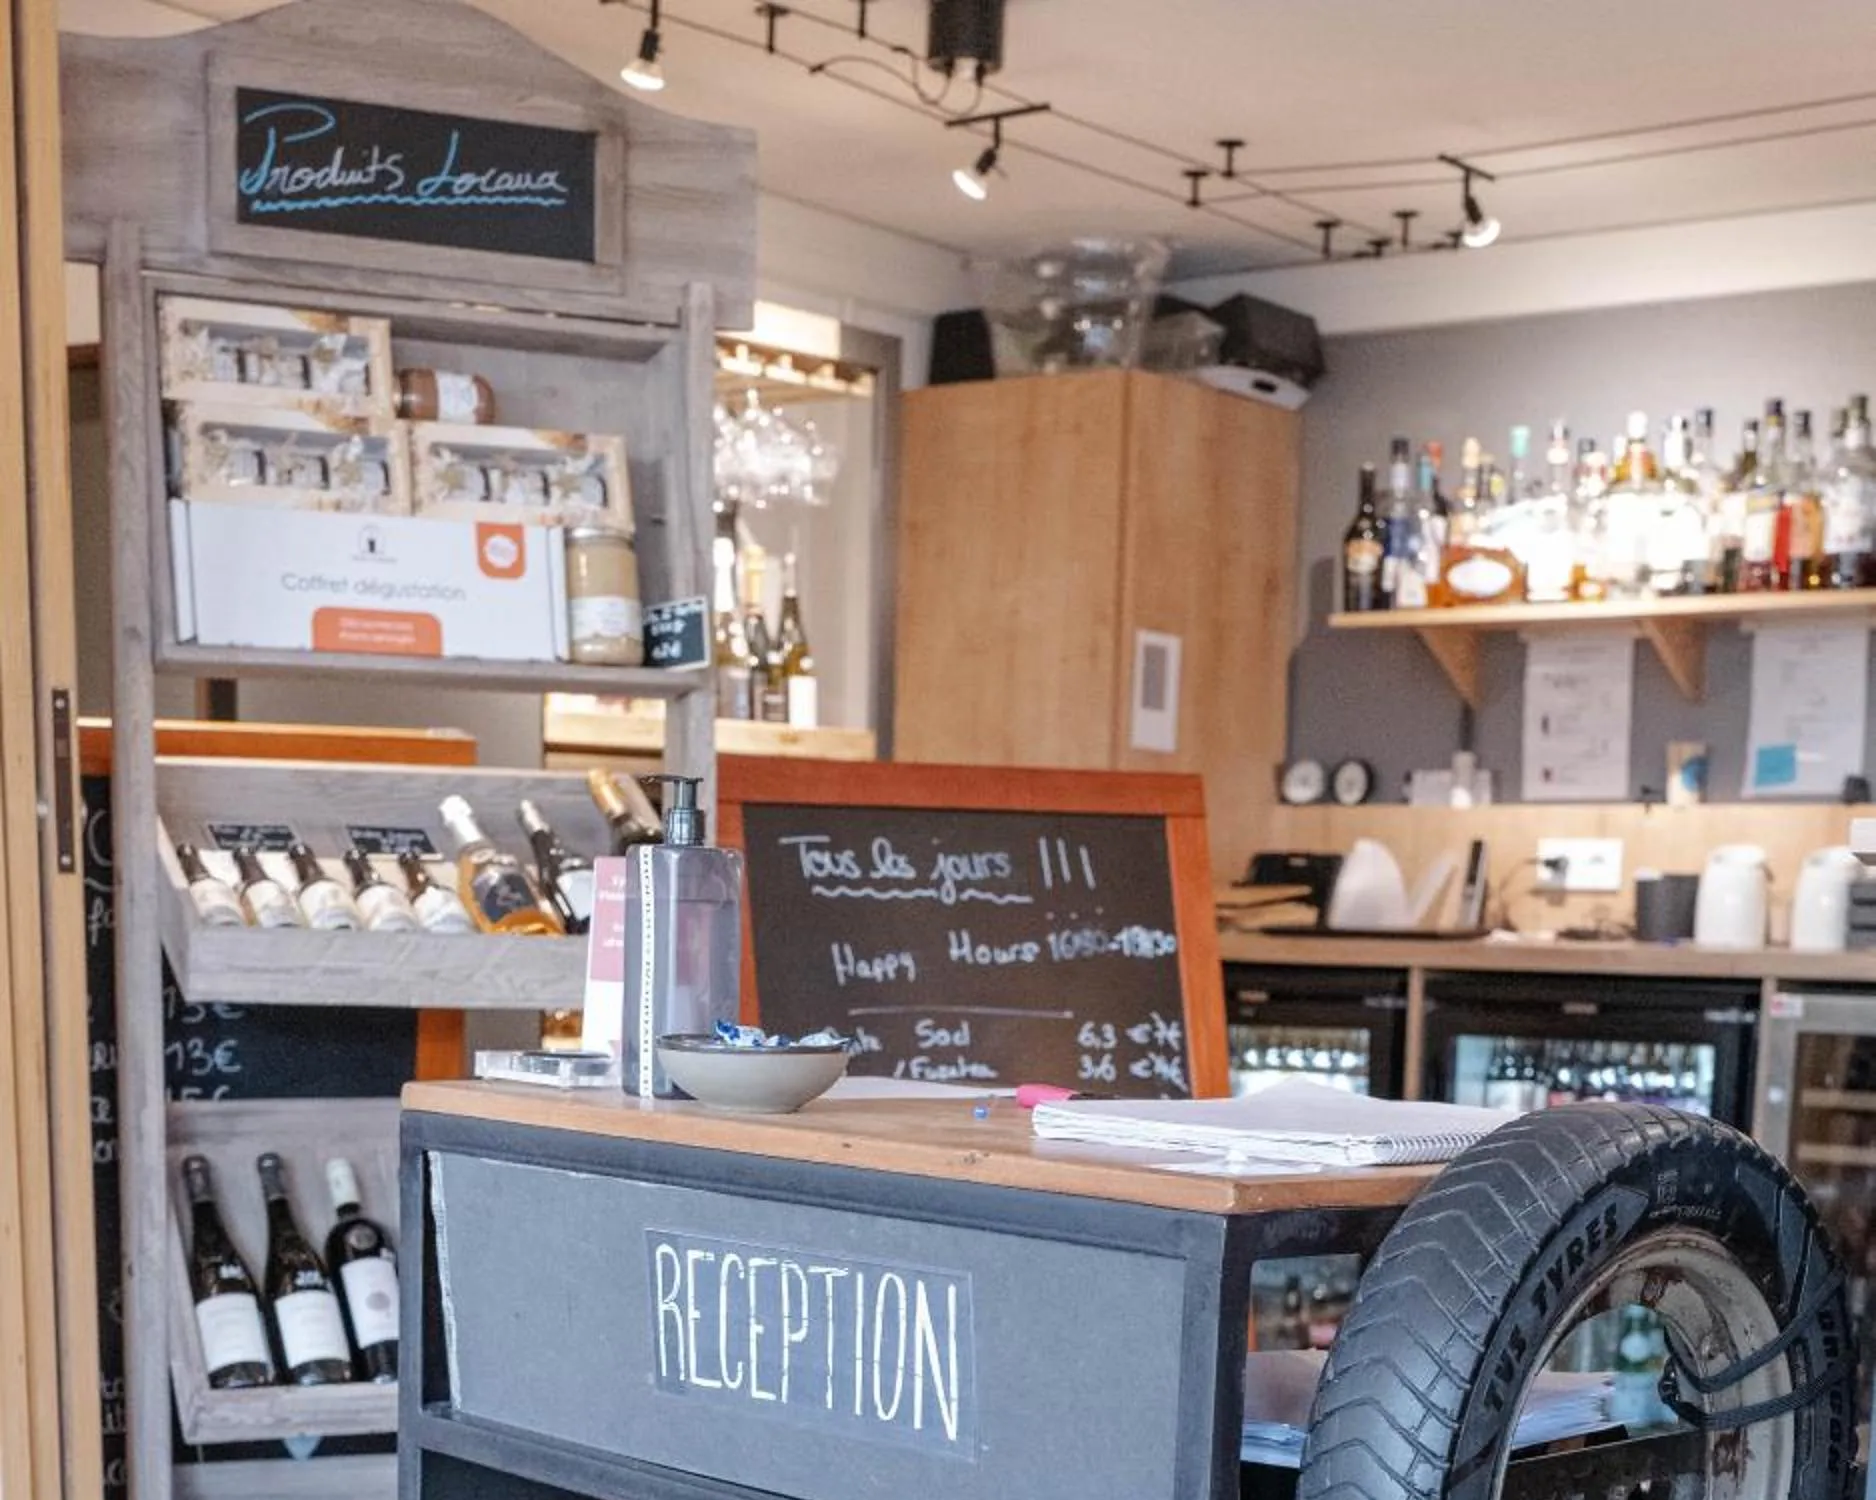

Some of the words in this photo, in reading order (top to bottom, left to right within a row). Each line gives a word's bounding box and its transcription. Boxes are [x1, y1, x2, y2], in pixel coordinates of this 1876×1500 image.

[239, 103, 404, 195] Produits
[281, 573, 349, 593] Coffret
[353, 576, 467, 602] dégustation
[779, 835, 862, 881] Tous
[930, 837, 1012, 905] jours
[831, 942, 917, 986] Happy
[164, 1038, 242, 1077] 13€
[655, 1243, 958, 1441] RECEPTION
[1482, 1322, 1528, 1413] TVS
[1530, 1202, 1618, 1317] TYRES
